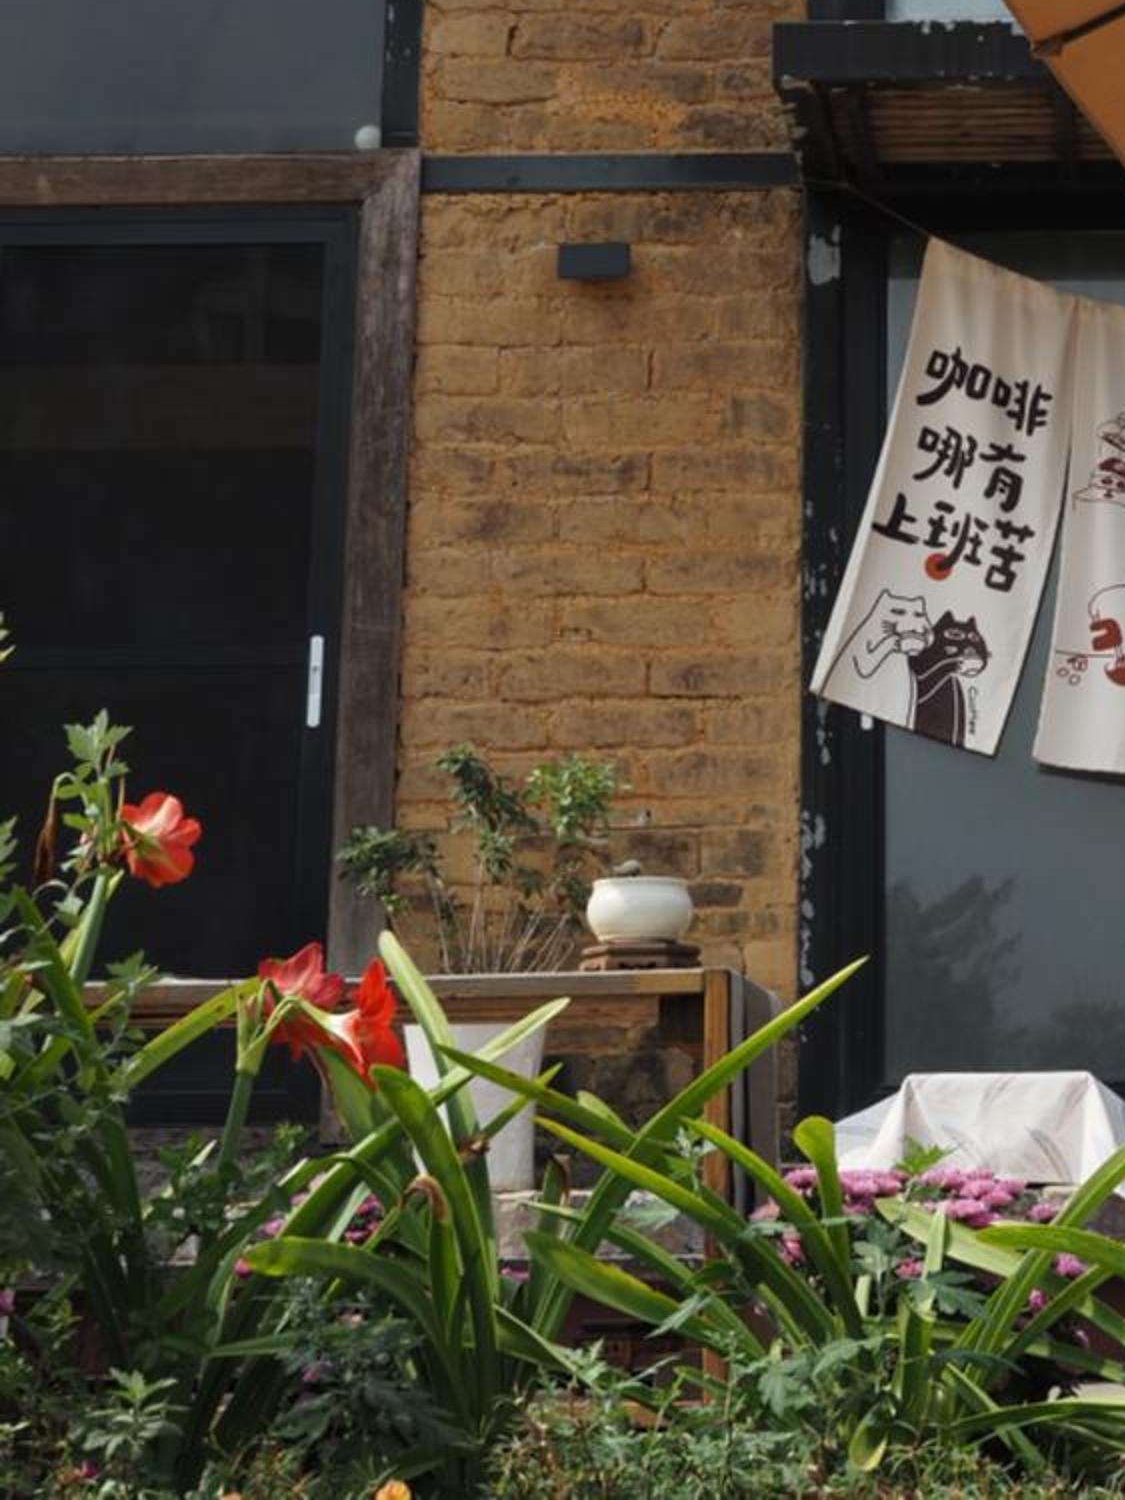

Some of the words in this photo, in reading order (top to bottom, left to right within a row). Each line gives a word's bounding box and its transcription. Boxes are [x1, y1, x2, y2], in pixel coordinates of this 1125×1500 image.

[916, 346, 1053, 437] 咖啡
[913, 425, 1027, 513] 哪有
[873, 492, 1035, 593] 上班苦
